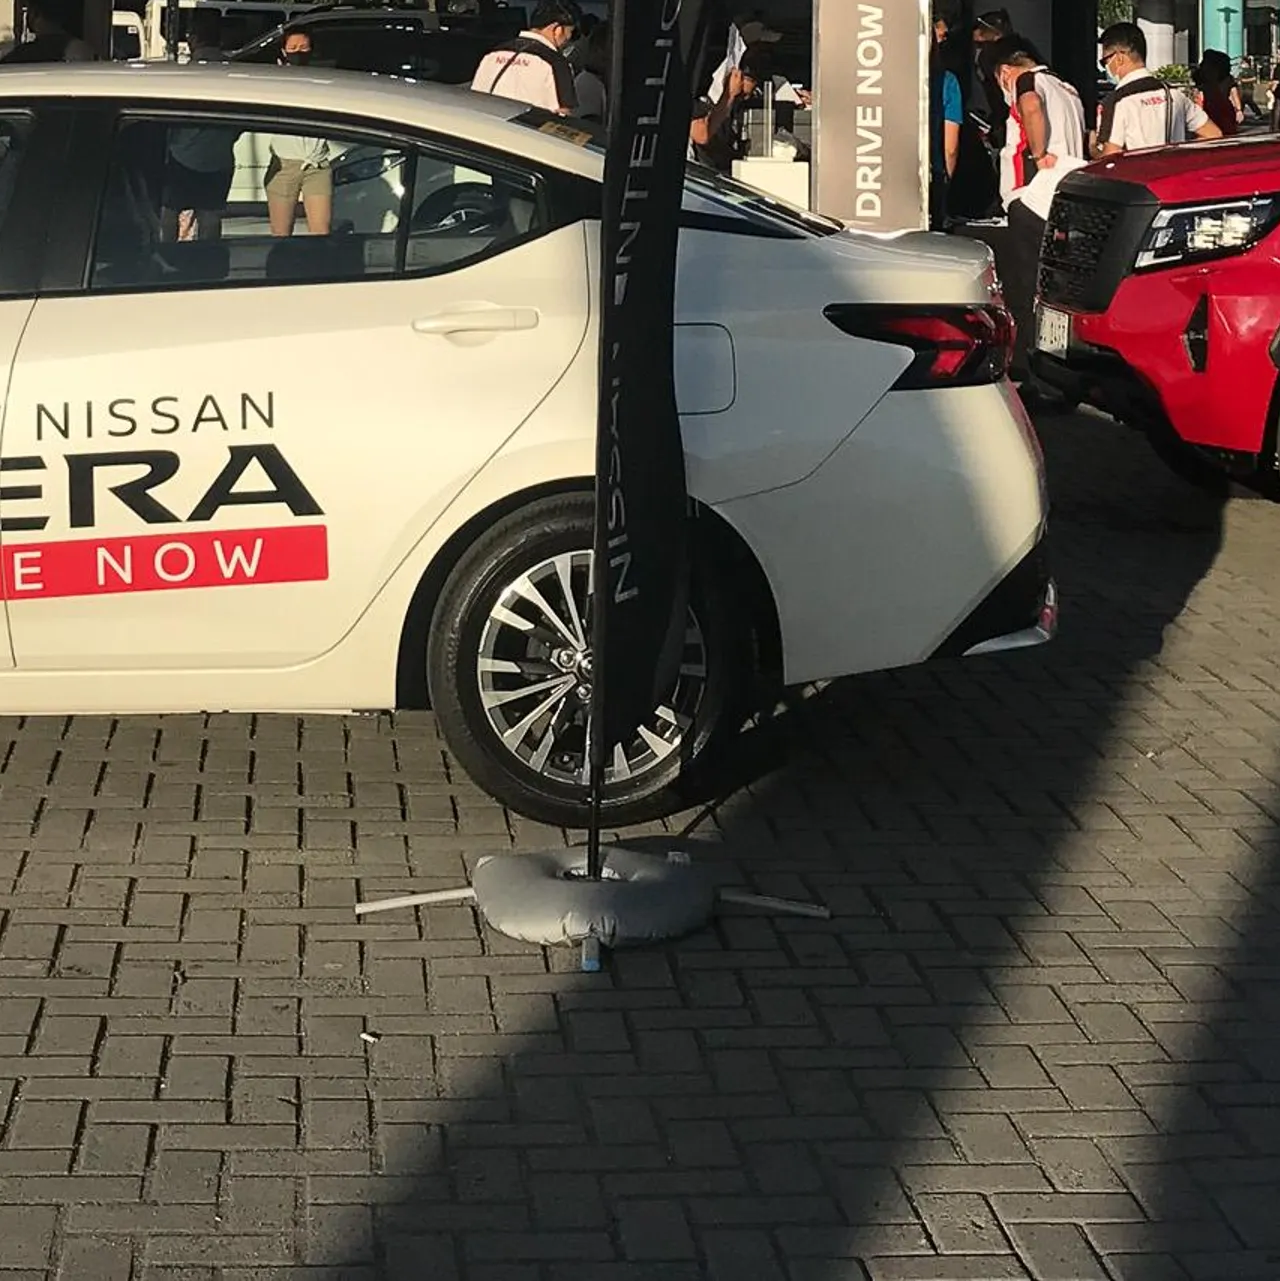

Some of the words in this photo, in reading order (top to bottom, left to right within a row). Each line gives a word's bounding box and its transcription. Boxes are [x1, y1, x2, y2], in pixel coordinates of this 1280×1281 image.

[856, 3, 884, 95] NOW
[856, 106, 883, 218] DRIVE
[36, 390, 276, 441] NISSAN
[96, 537, 267, 587] NOW
